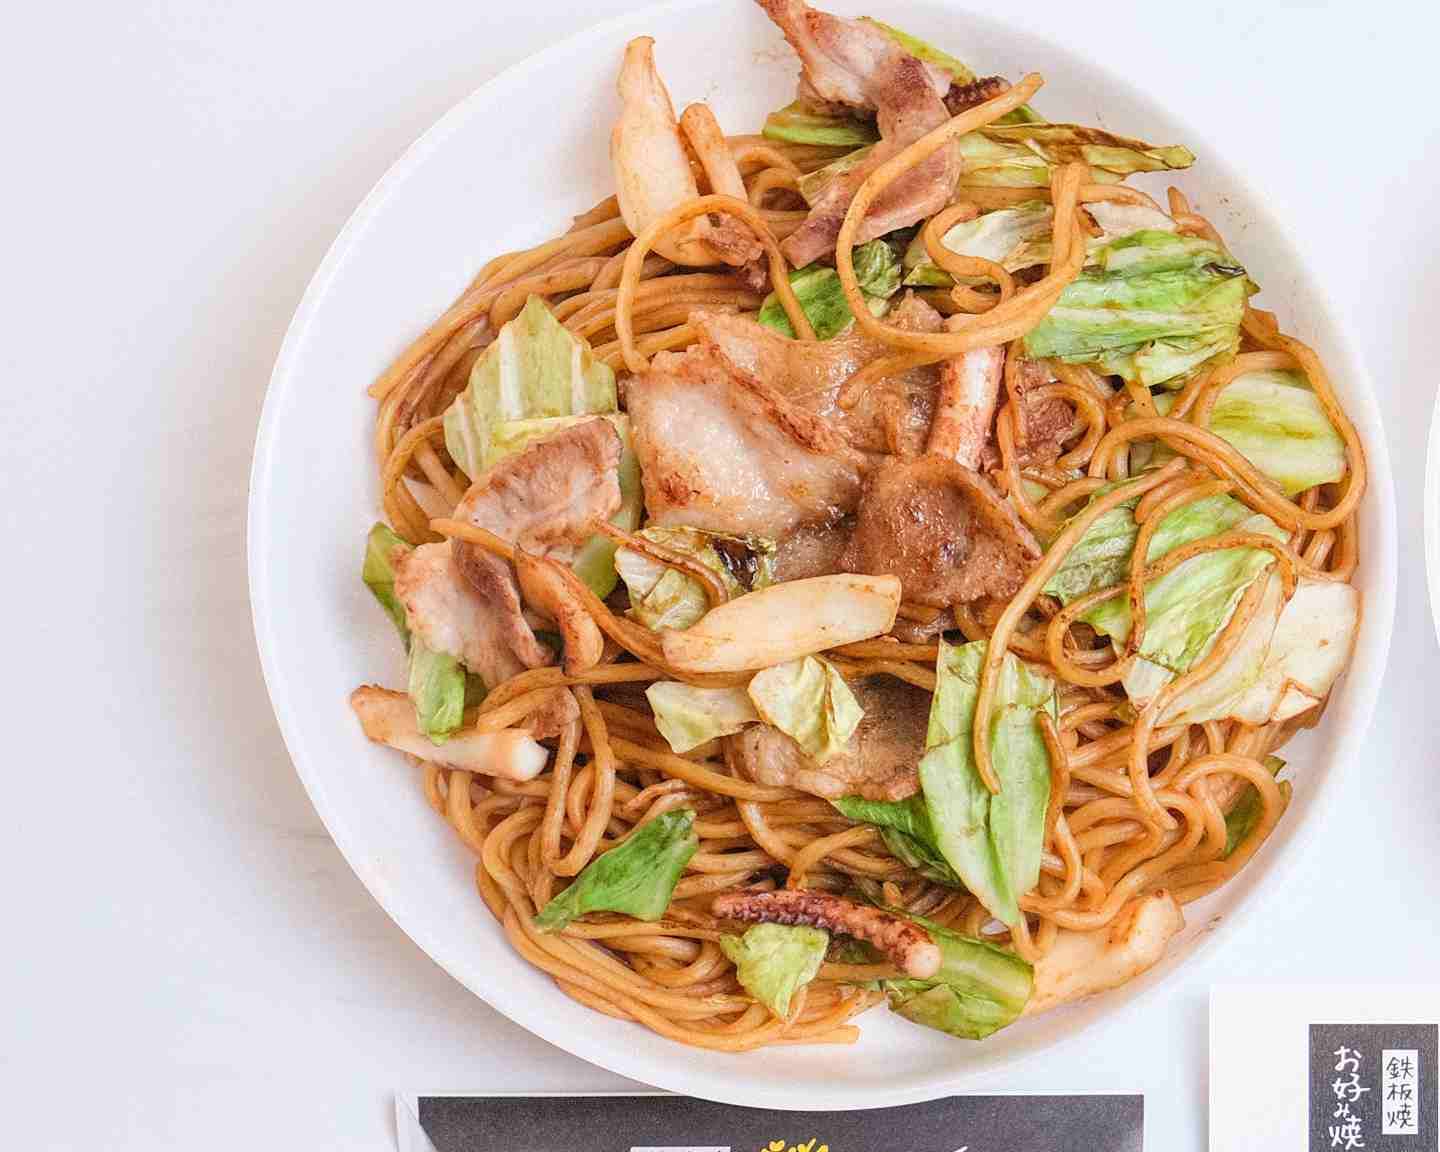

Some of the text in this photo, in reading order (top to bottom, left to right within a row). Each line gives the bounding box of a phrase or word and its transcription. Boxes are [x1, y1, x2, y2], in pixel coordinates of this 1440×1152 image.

[1328, 1046, 1371, 1151] お好み焼
[1386, 1056, 1416, 1129] 鉄板焼
